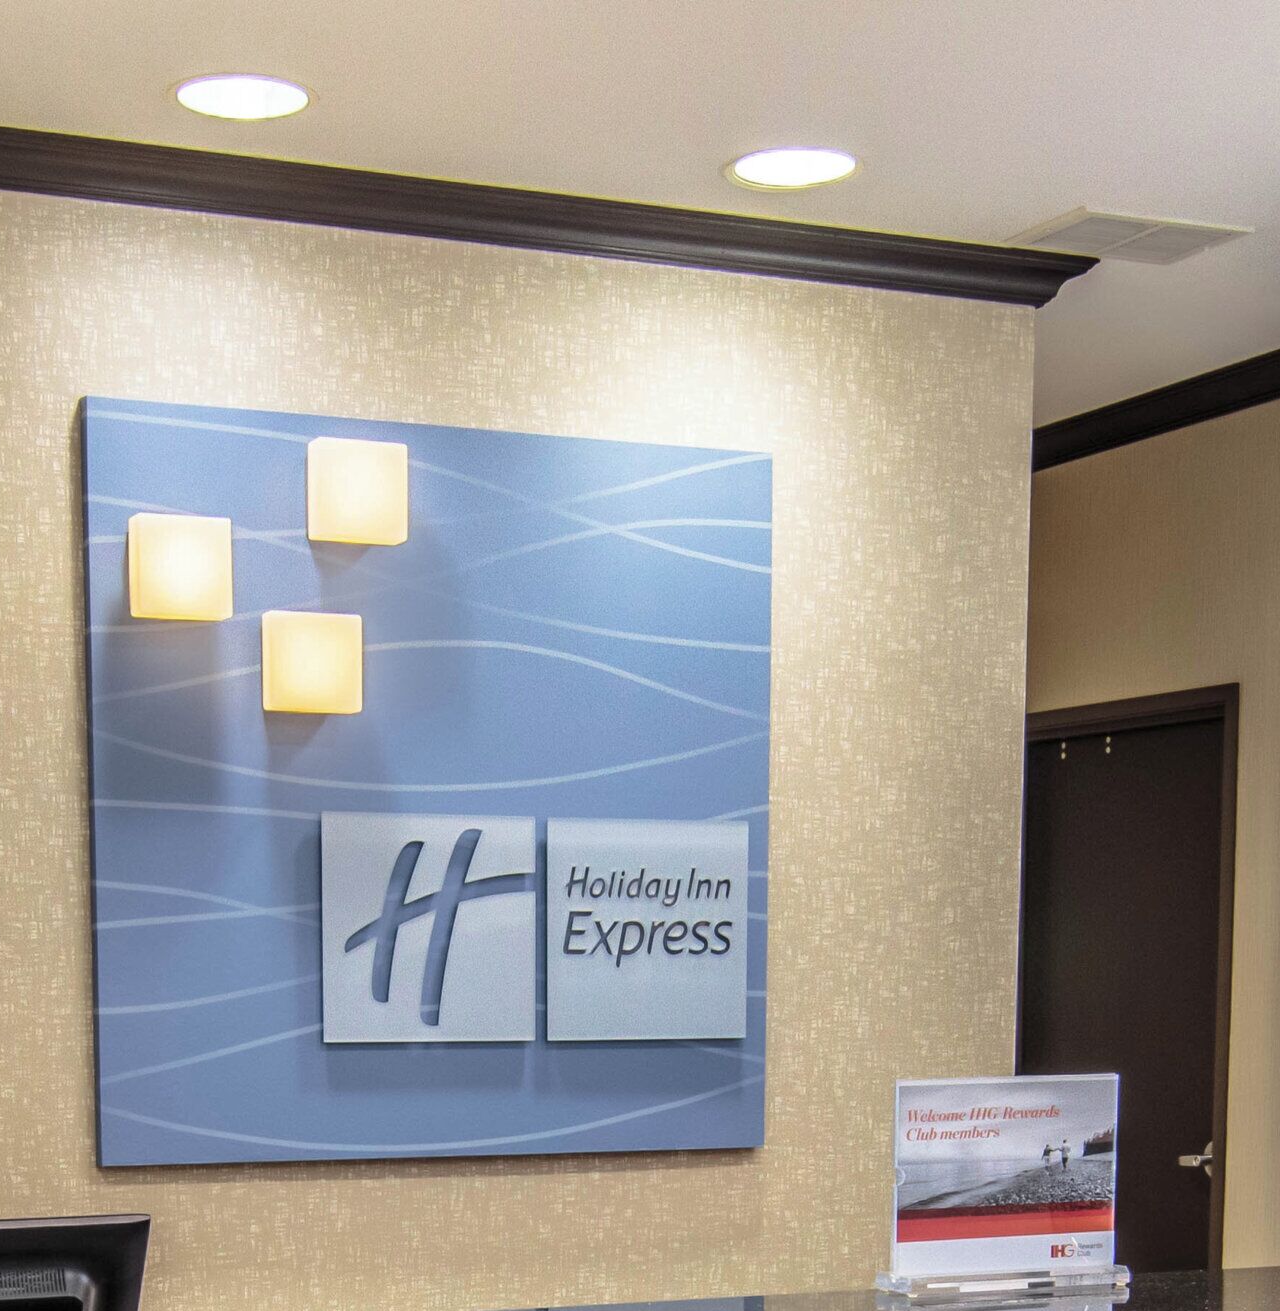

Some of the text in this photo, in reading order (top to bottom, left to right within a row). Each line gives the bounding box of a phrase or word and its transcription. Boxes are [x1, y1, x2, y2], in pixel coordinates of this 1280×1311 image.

[565, 866, 731, 907] Holiday Inn
[562, 910, 733, 968] Express
[907, 1104, 1062, 1123] Welcome IHG Rewards
[906, 1125, 1001, 1142] Club members
[1050, 1244, 1075, 1259] IHG
